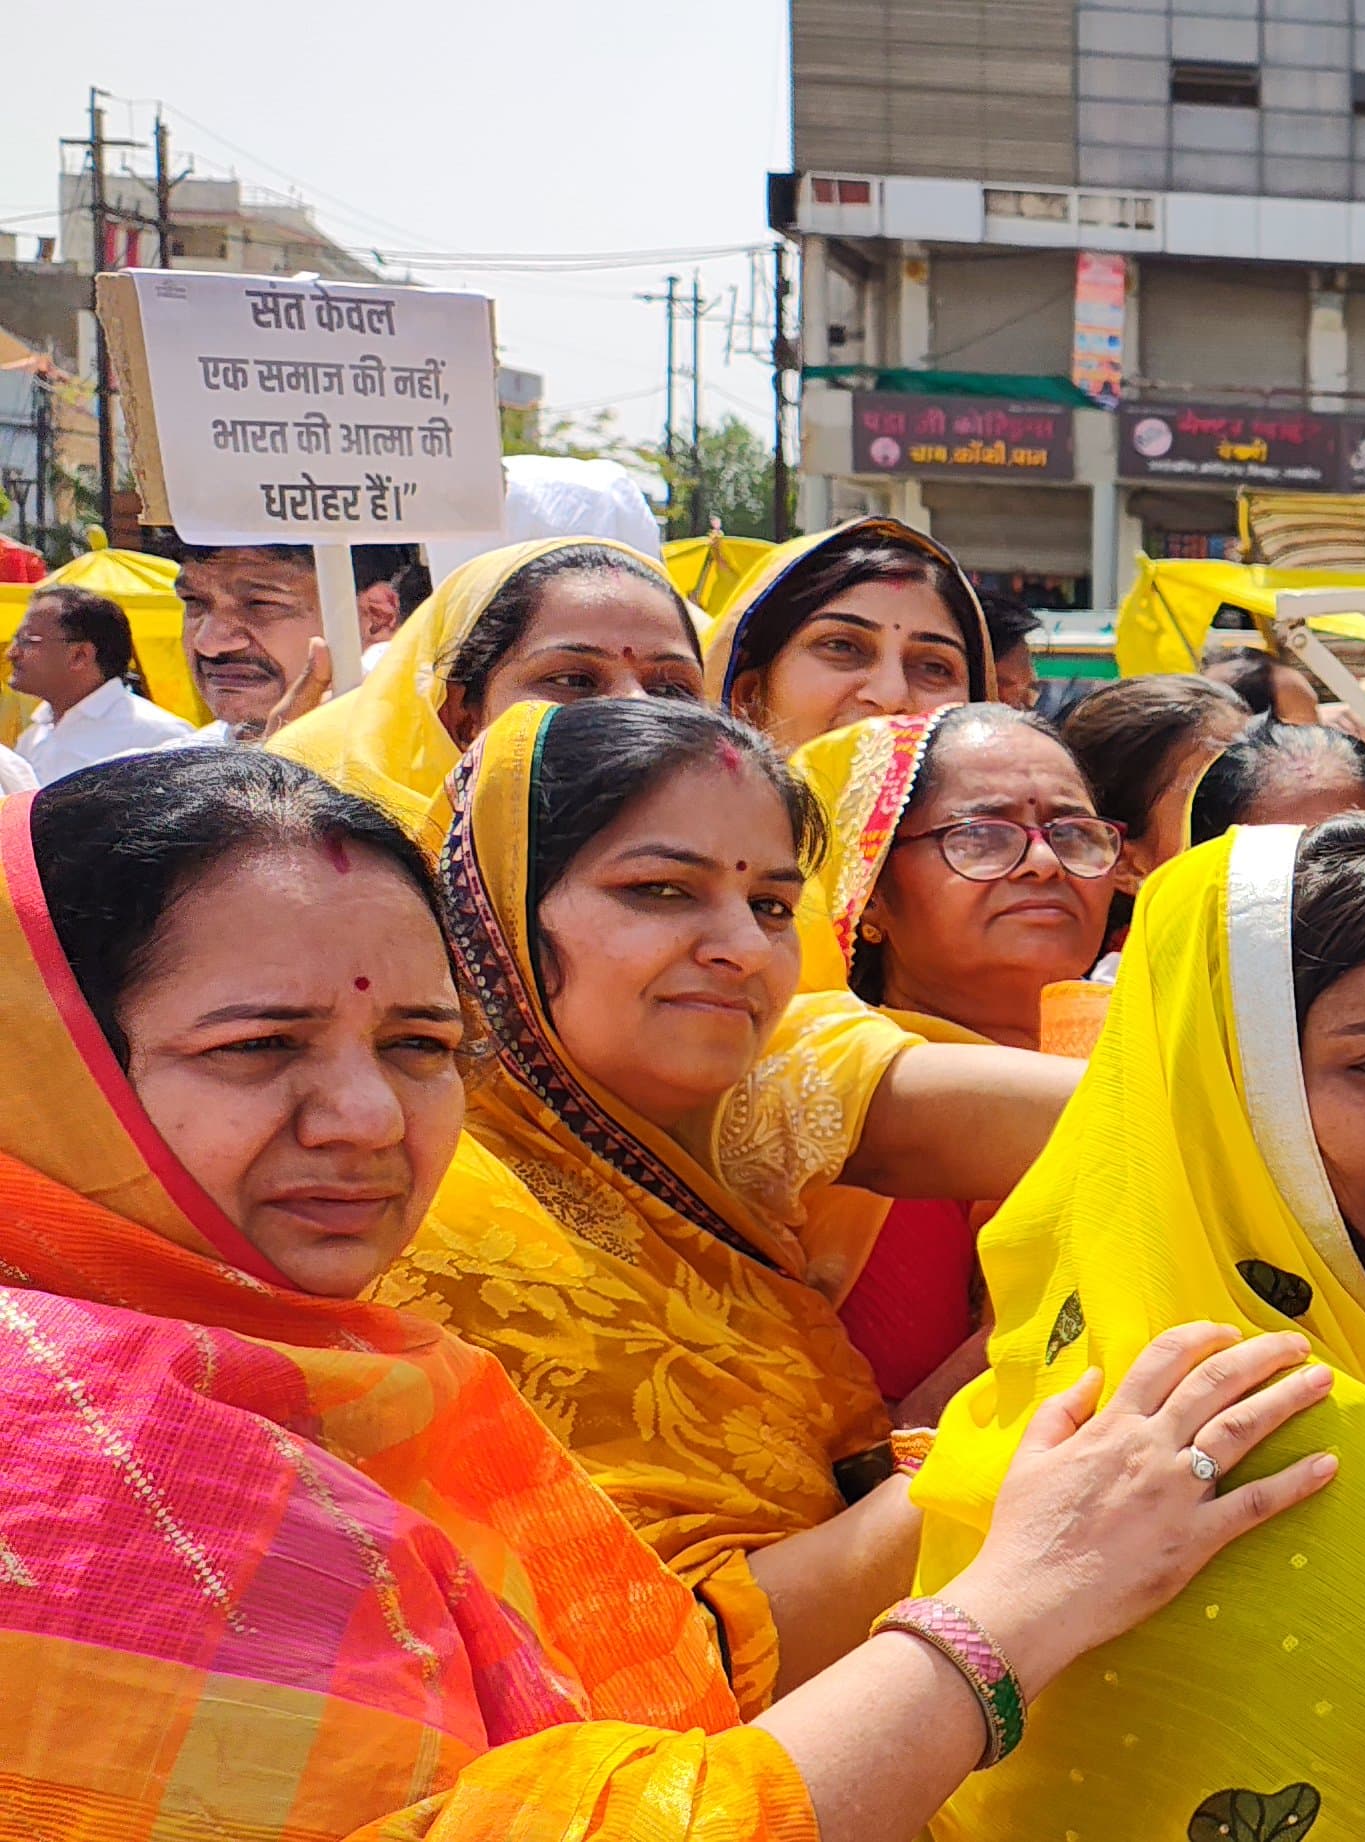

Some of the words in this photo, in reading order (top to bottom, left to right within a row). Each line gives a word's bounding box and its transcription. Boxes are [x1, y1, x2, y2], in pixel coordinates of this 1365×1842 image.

[245, 281, 306, 331] संत
[309, 283, 396, 336] केवल
[198, 356, 249, 391] एक
[254, 359, 344, 395] समाज
[349, 354, 386, 397] की
[391, 358, 450, 405] नहीं,
[211, 418, 289, 454] भारत
[293, 411, 331, 455] की
[340, 423, 414, 457] आत्मा
[417, 417, 453, 458] की
[260, 472, 361, 521] धरोहर
